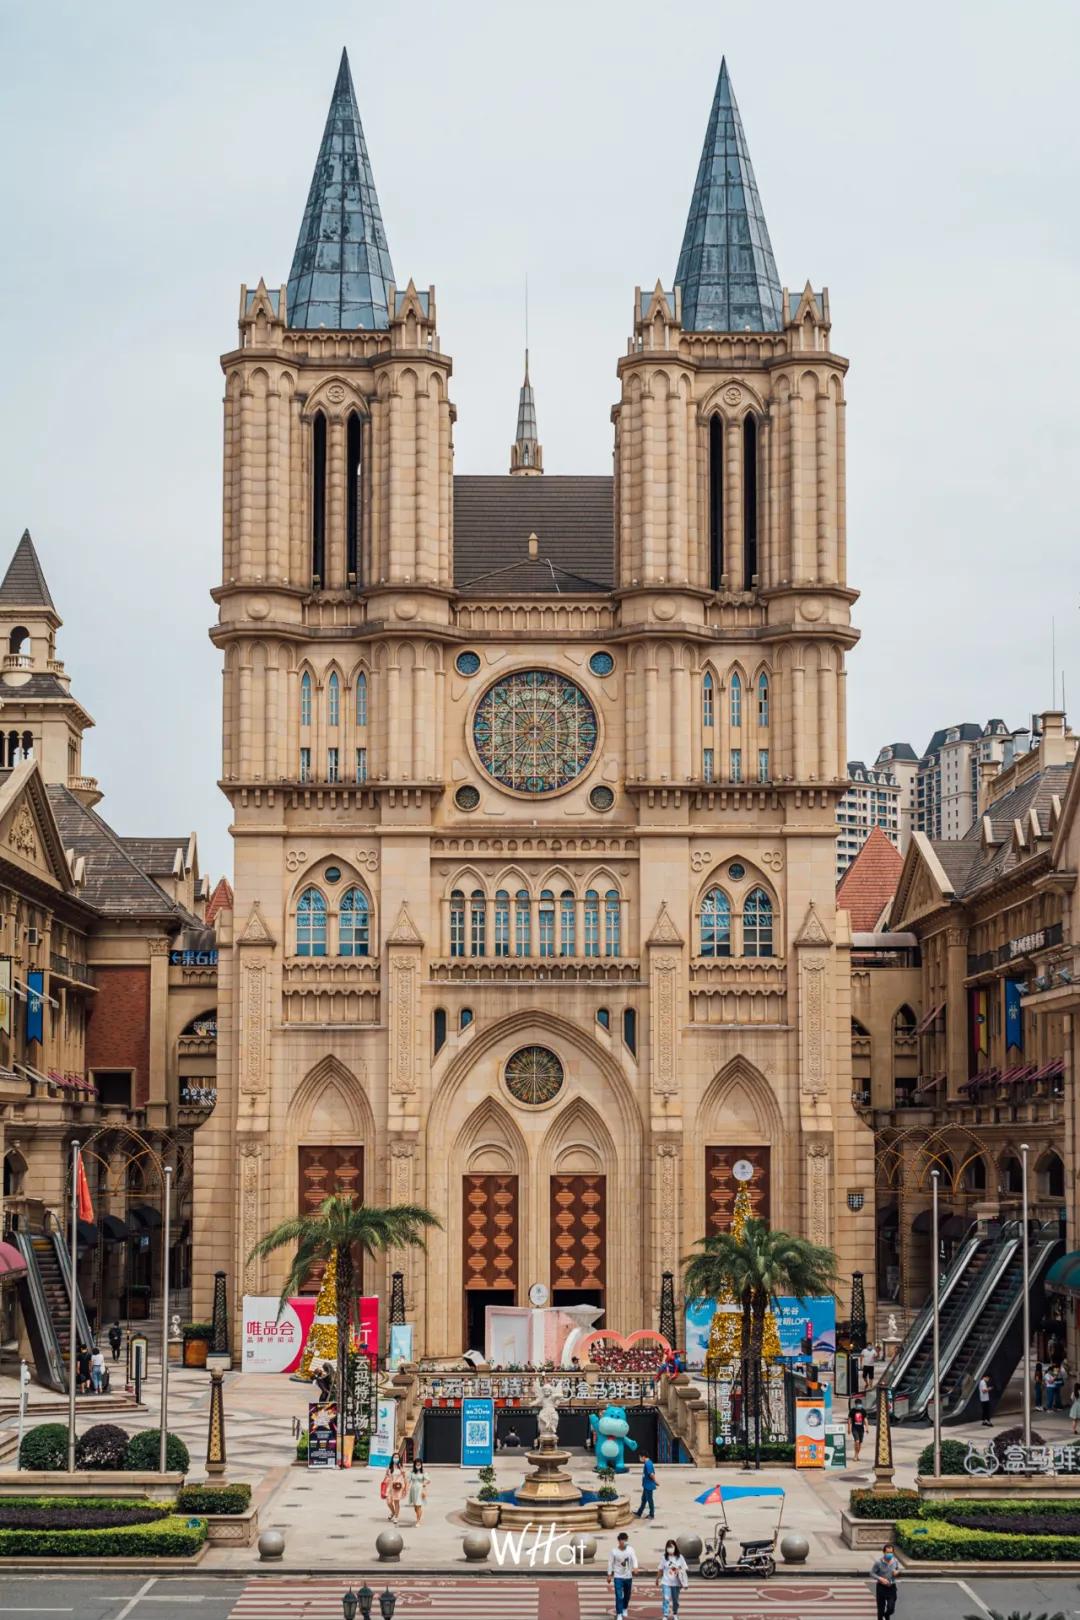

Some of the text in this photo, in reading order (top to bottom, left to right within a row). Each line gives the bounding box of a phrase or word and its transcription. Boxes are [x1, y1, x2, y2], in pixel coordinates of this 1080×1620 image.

[246, 1321, 295, 1336] 唯品会
[354, 1356, 371, 1430] 云玛特广场
[575, 1382, 641, 1399] 盒马鲜生
